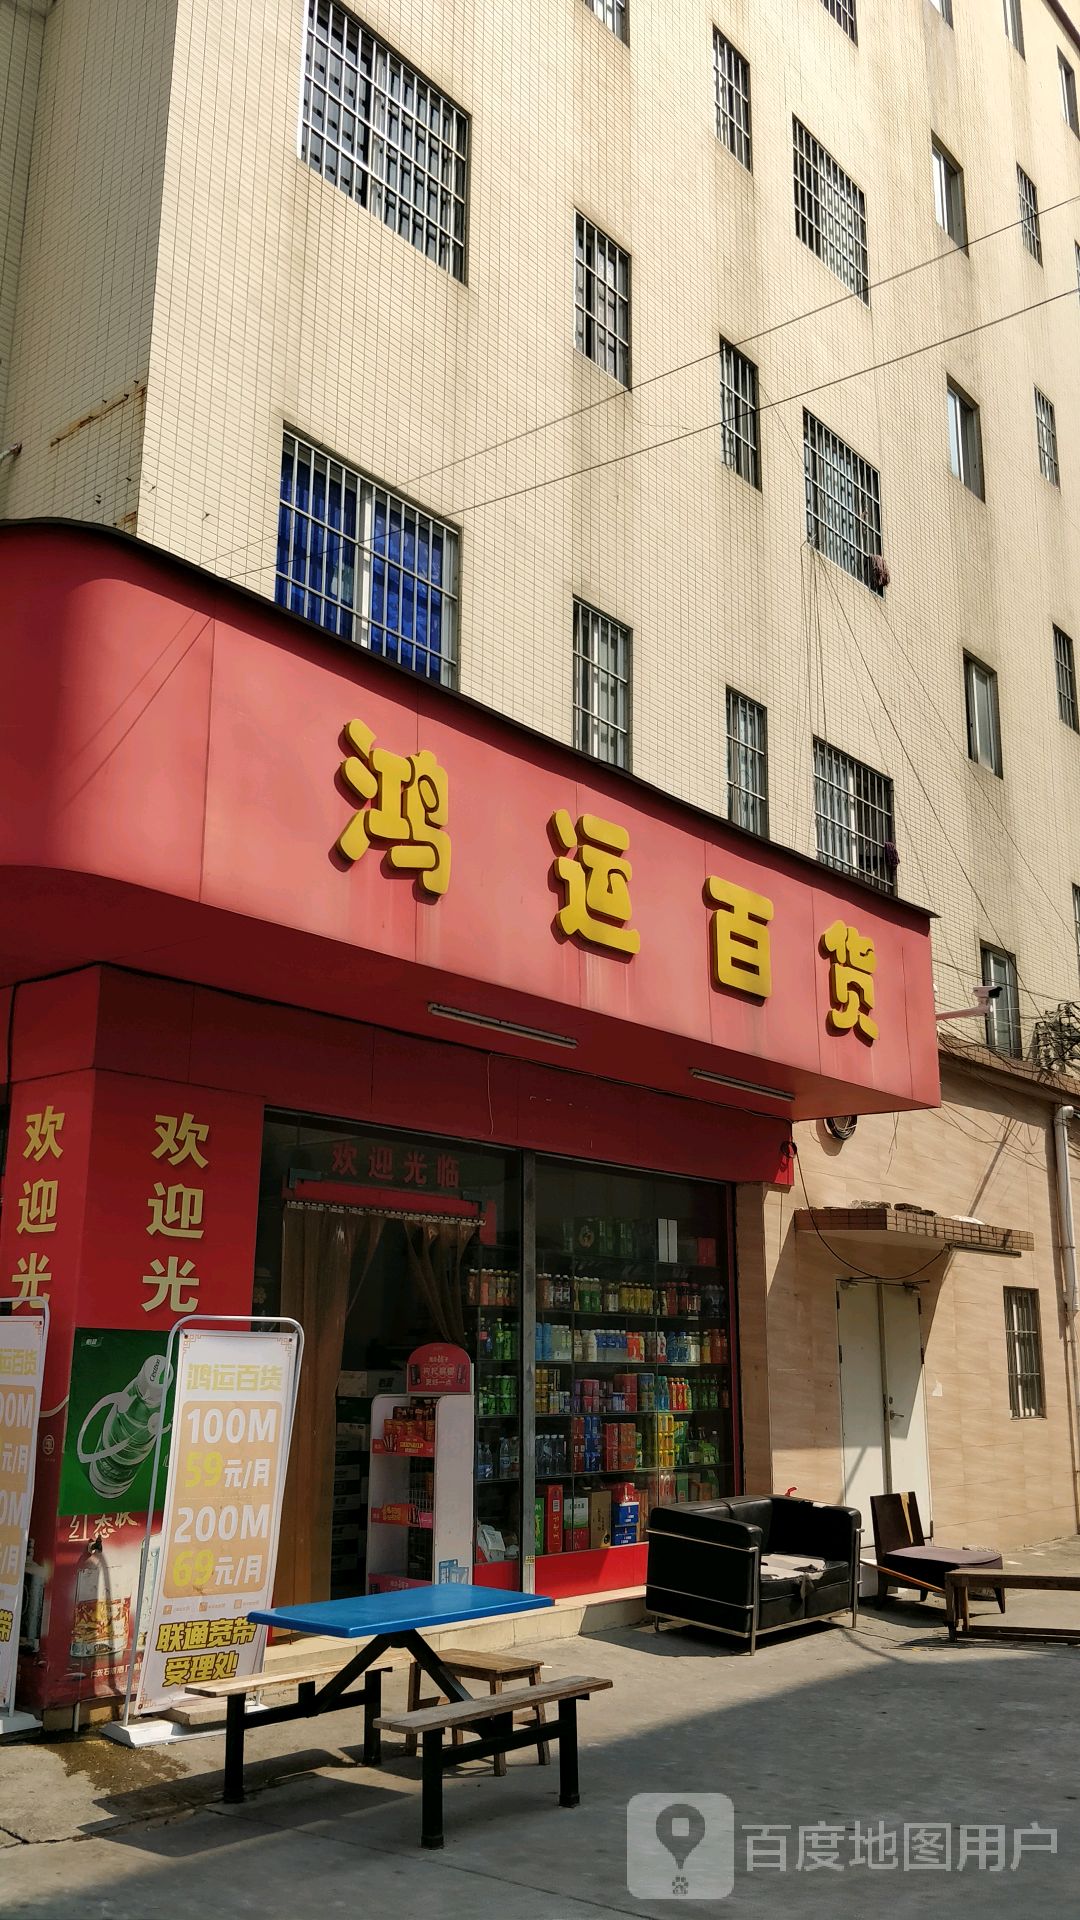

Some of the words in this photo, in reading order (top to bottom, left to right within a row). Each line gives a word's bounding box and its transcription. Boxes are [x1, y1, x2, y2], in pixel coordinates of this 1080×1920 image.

[337, 718, 880, 1041] 鸿运百货
[330, 1142, 461, 1190] 欢迎光临
[141, 1112, 209, 1313] 欢迎光
[186, 1363, 283, 1392] 鸿运百货
[187, 1408, 277, 1443] 100M
[185, 1452, 271, 1489] 59元/月
[174, 1503, 271, 1543] 200M
[172, 1549, 263, 1587] 69元/月
[155, 1617, 257, 1653] 联通宽带
[162, 1650, 240, 1688] 受理处
